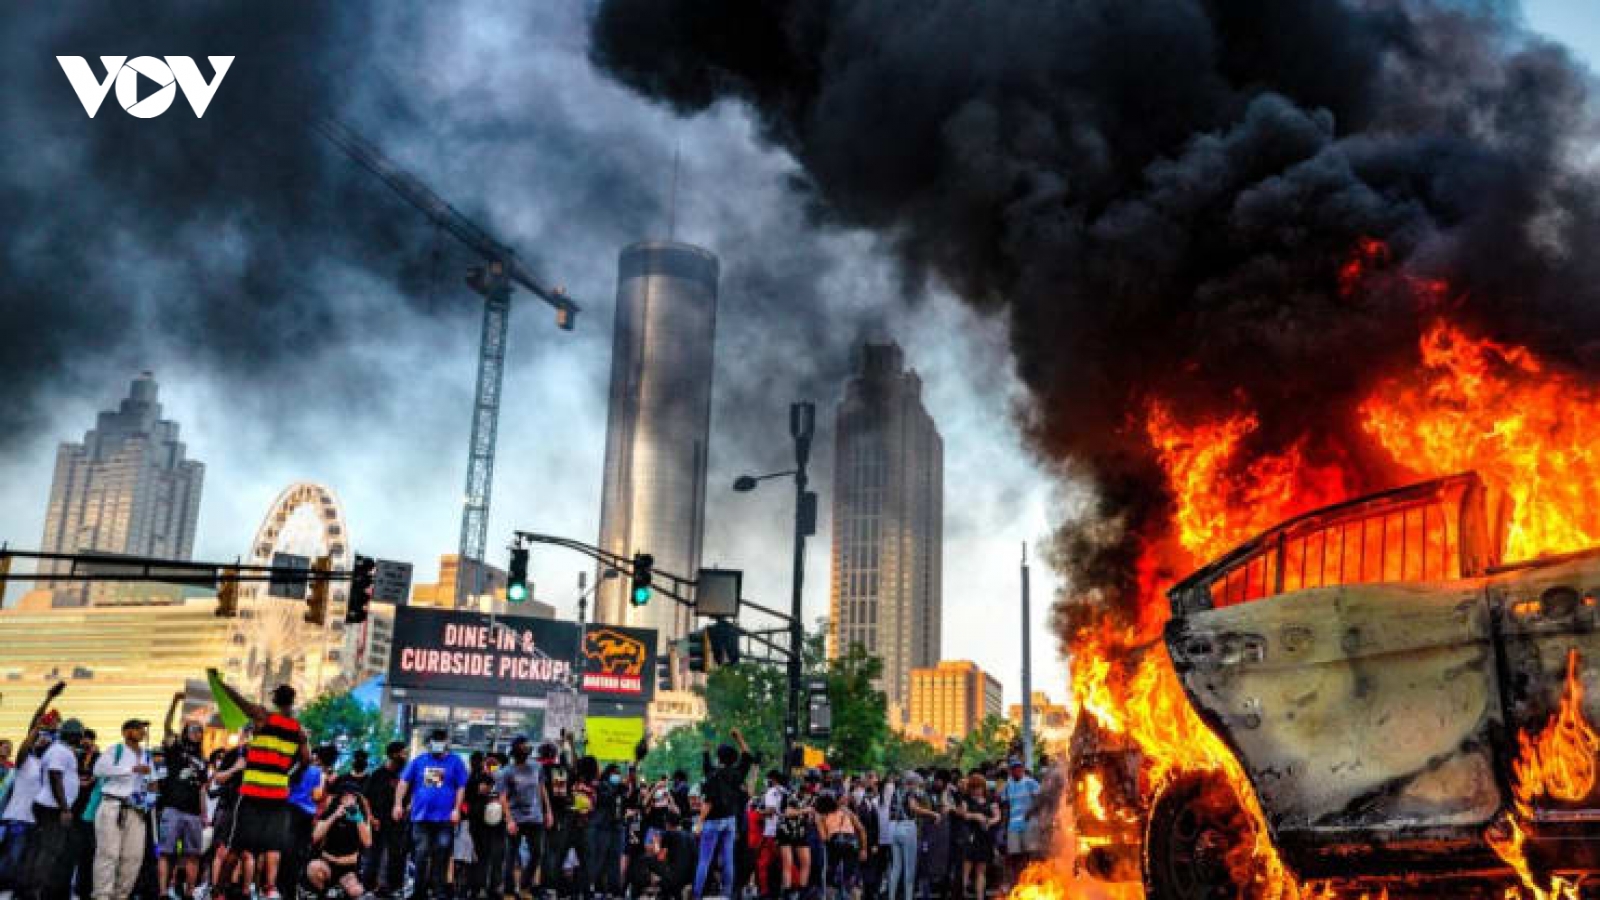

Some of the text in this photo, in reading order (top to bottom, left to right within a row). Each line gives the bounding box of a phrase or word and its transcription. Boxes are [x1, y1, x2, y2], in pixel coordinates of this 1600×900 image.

[444, 623, 534, 652] DINE-IN &
[401, 648, 494, 676] CURBSIDE
